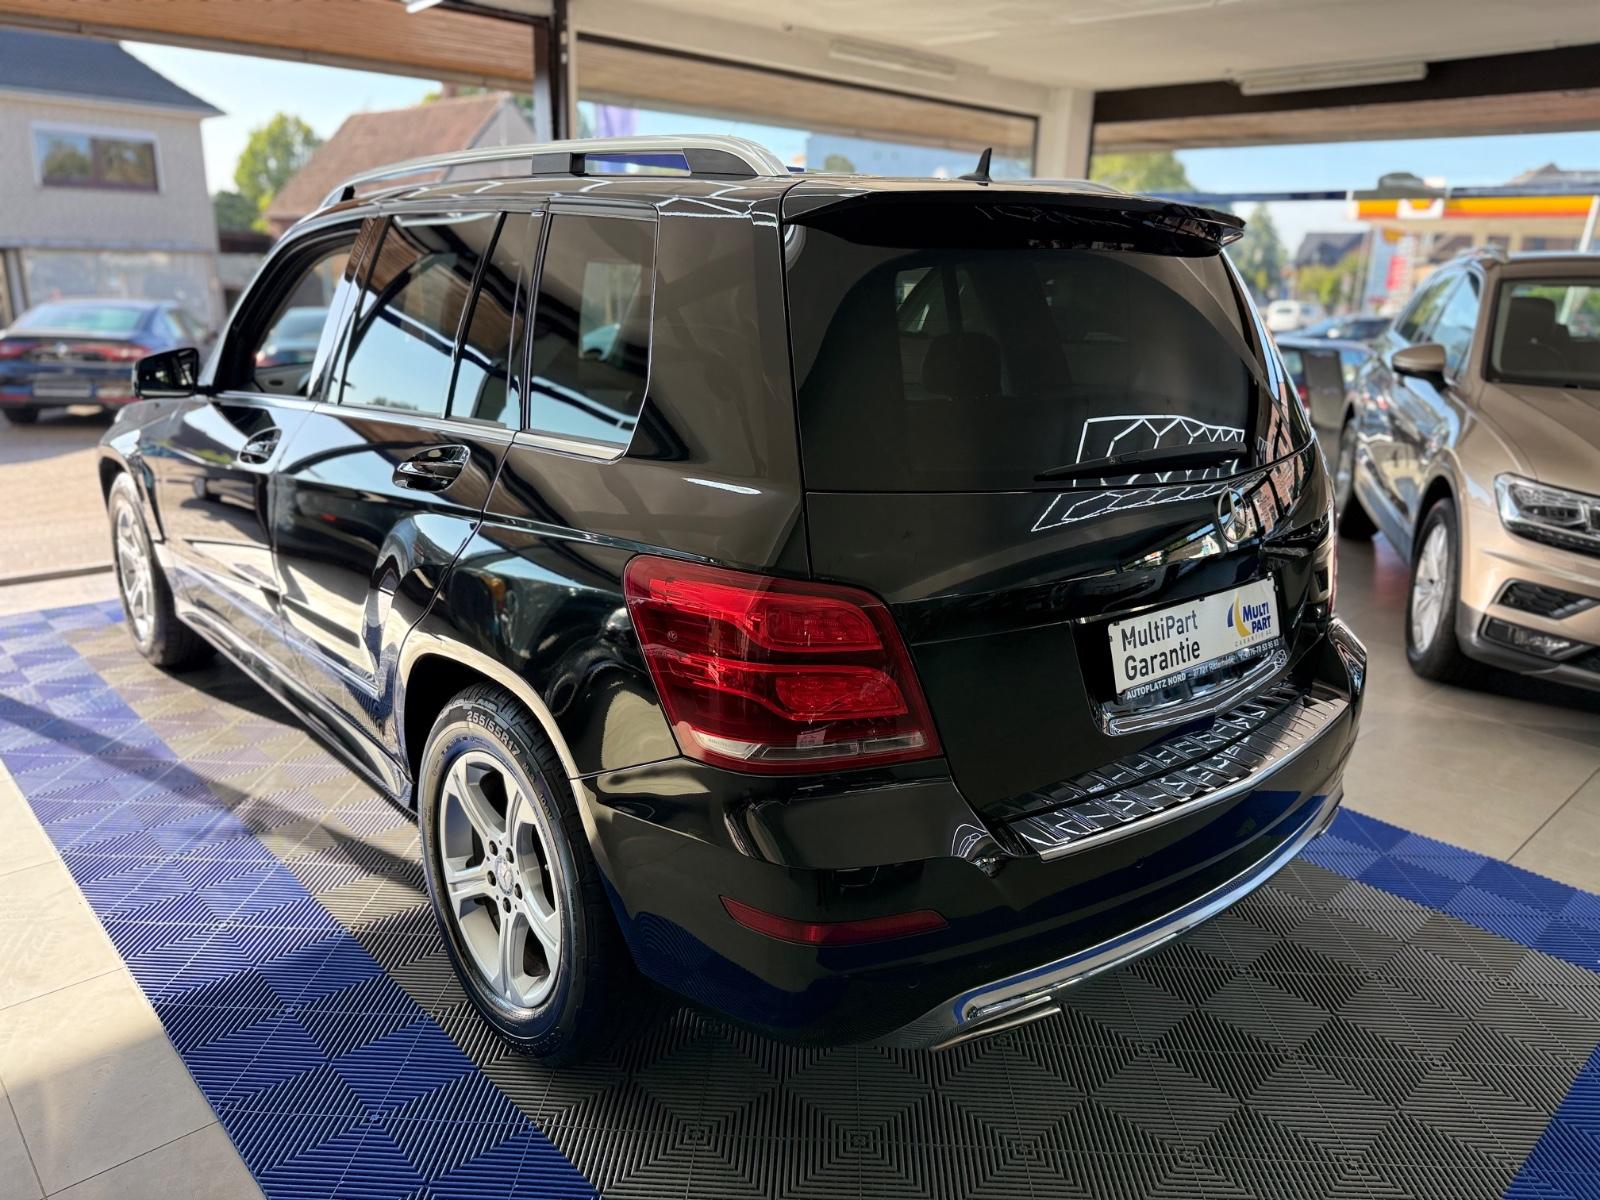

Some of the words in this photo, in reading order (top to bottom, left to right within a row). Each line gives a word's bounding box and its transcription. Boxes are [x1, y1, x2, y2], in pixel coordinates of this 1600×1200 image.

[1242, 601, 1270, 623] MULTI
[1251, 615, 1271, 634] PART
[1121, 610, 1198, 652] MultiPart
[1124, 637, 1201, 681] Garantie
[1125, 679, 1168, 700] AUTOPLATZ
[1167, 672, 1187, 687] NORD
